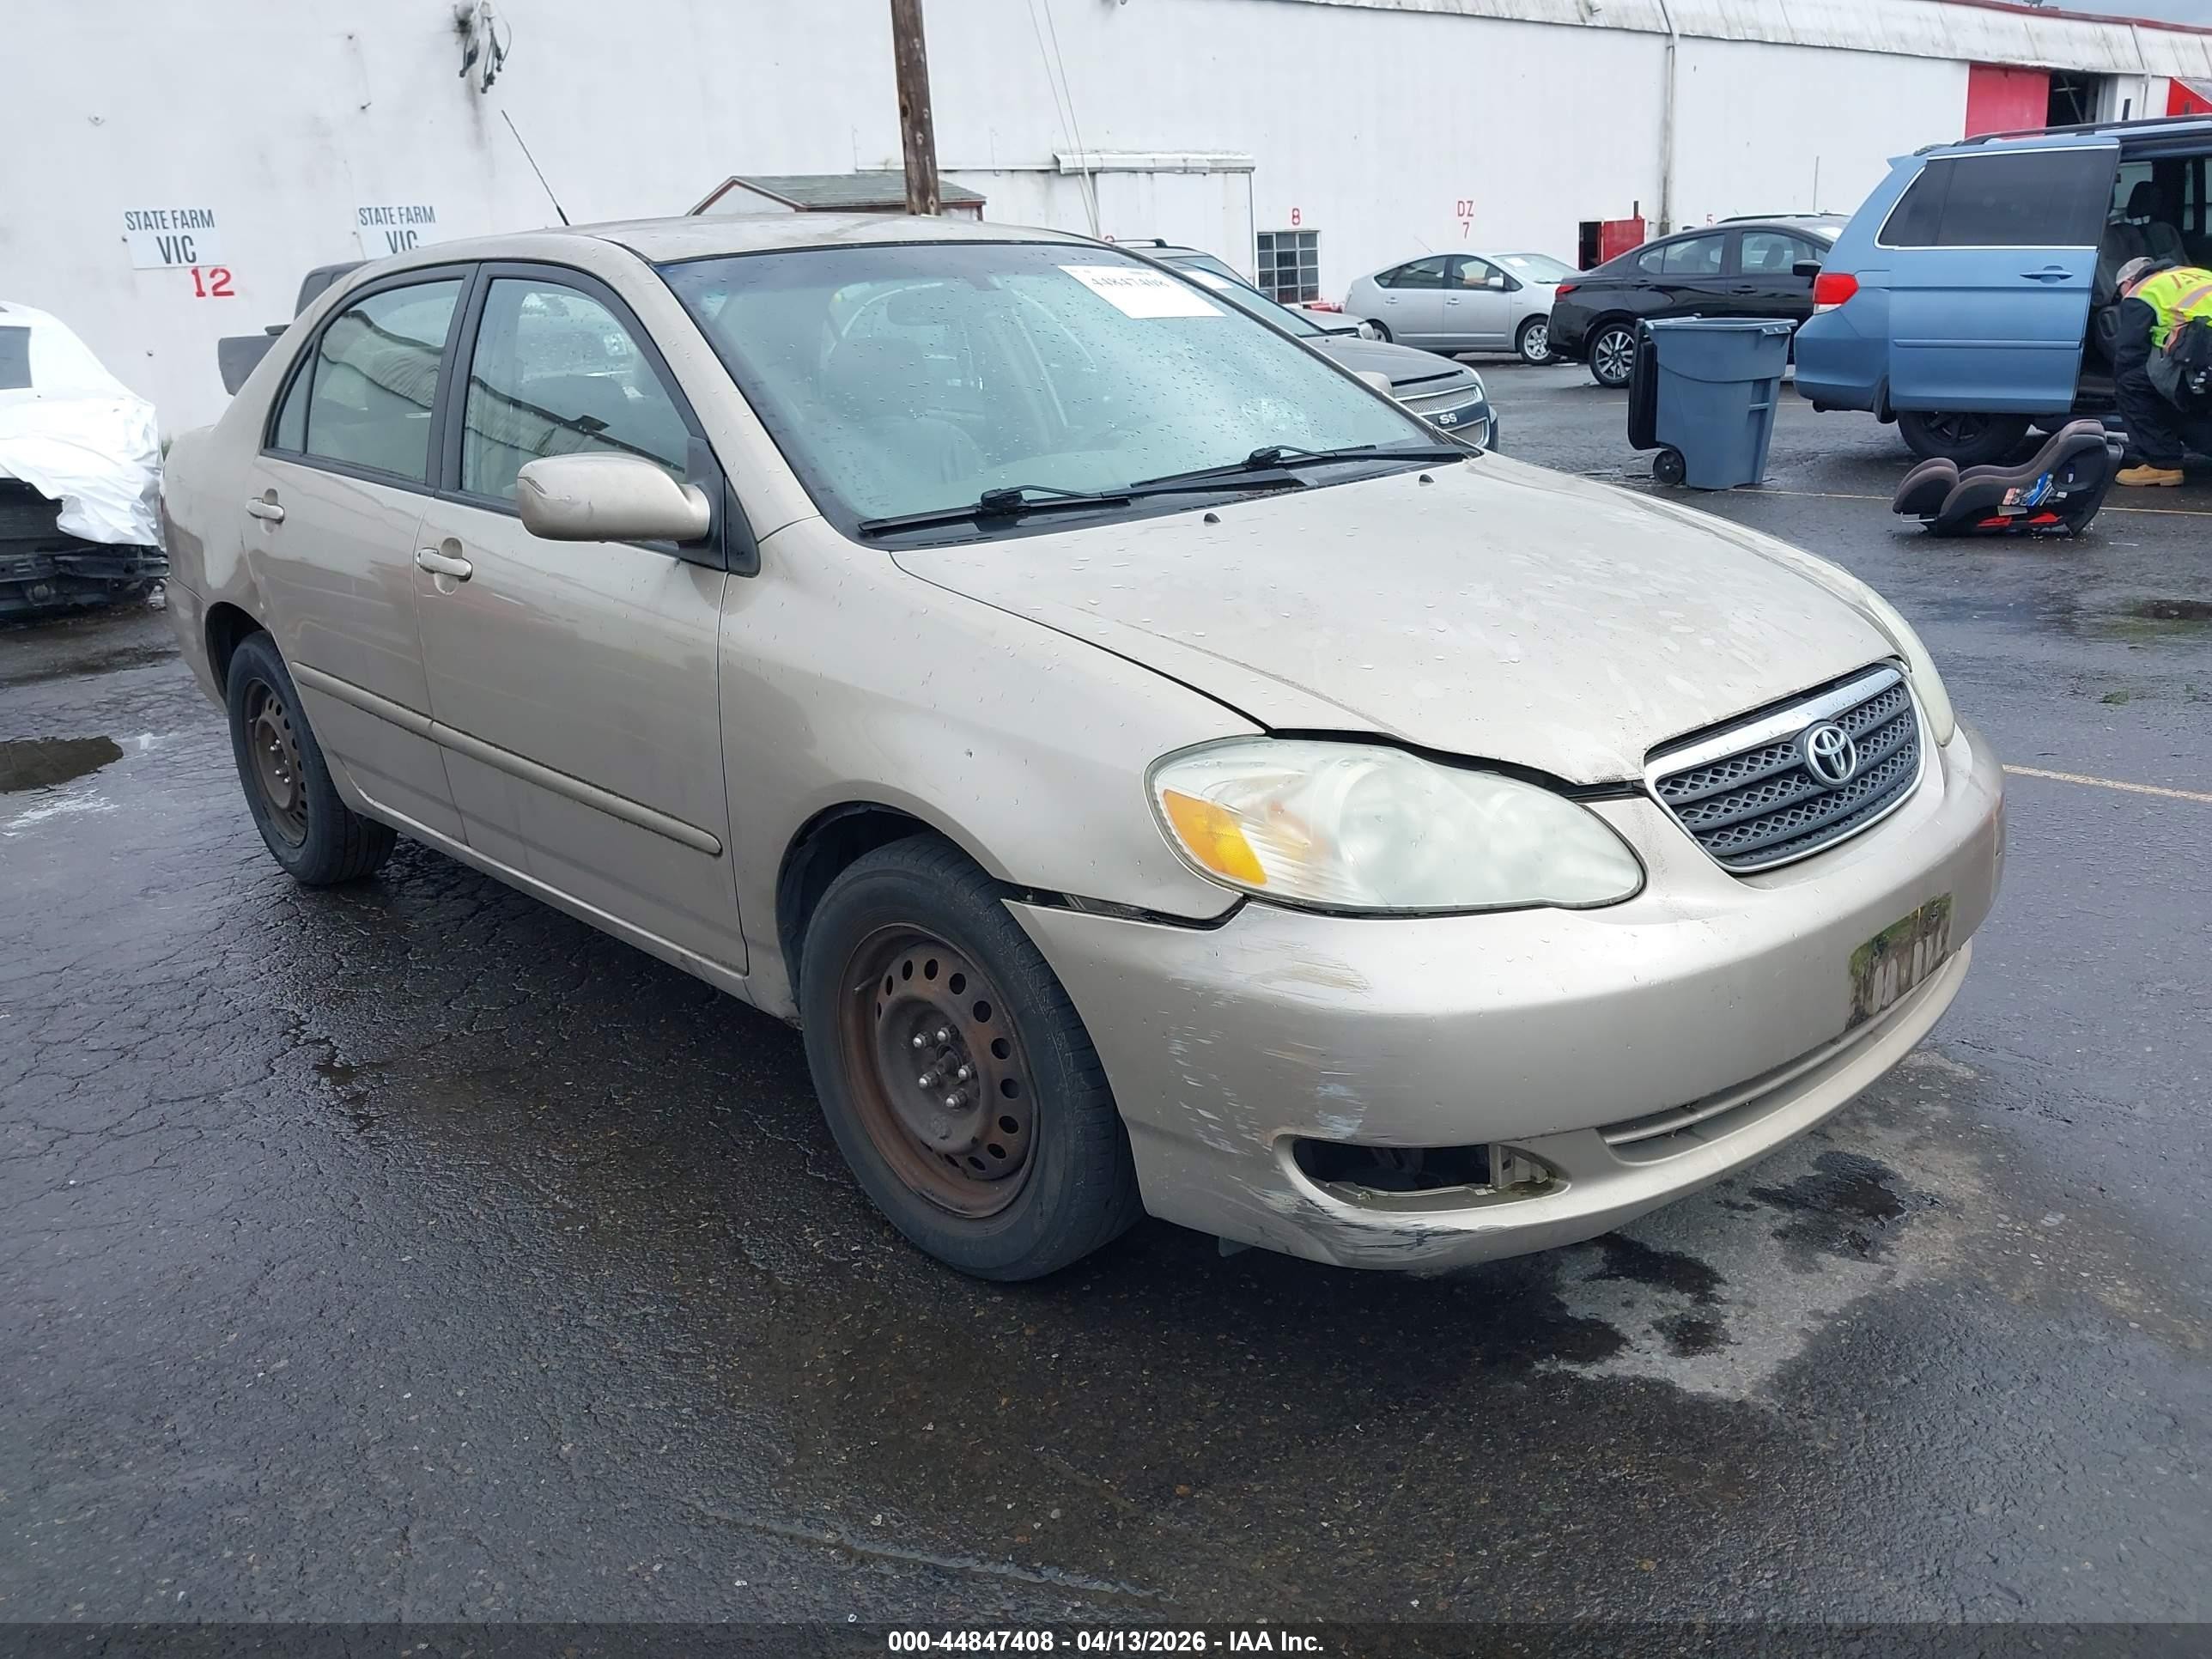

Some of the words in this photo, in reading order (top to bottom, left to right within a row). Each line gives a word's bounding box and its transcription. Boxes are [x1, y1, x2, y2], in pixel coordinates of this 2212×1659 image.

[358, 207, 397, 226] STATE
[398, 205, 436, 224] FARM
[1291, 207, 1301, 225] 8
[1457, 200, 1474, 217] DZ
[125, 210, 169, 231] STATE
[171, 209, 216, 229] FARM
[1462, 222, 1470, 239] 7
[156, 234, 198, 264] VIC
[385, 229, 419, 254] VIC
[191, 266, 235, 297] 12
[1439, 412, 1457, 424] SS
